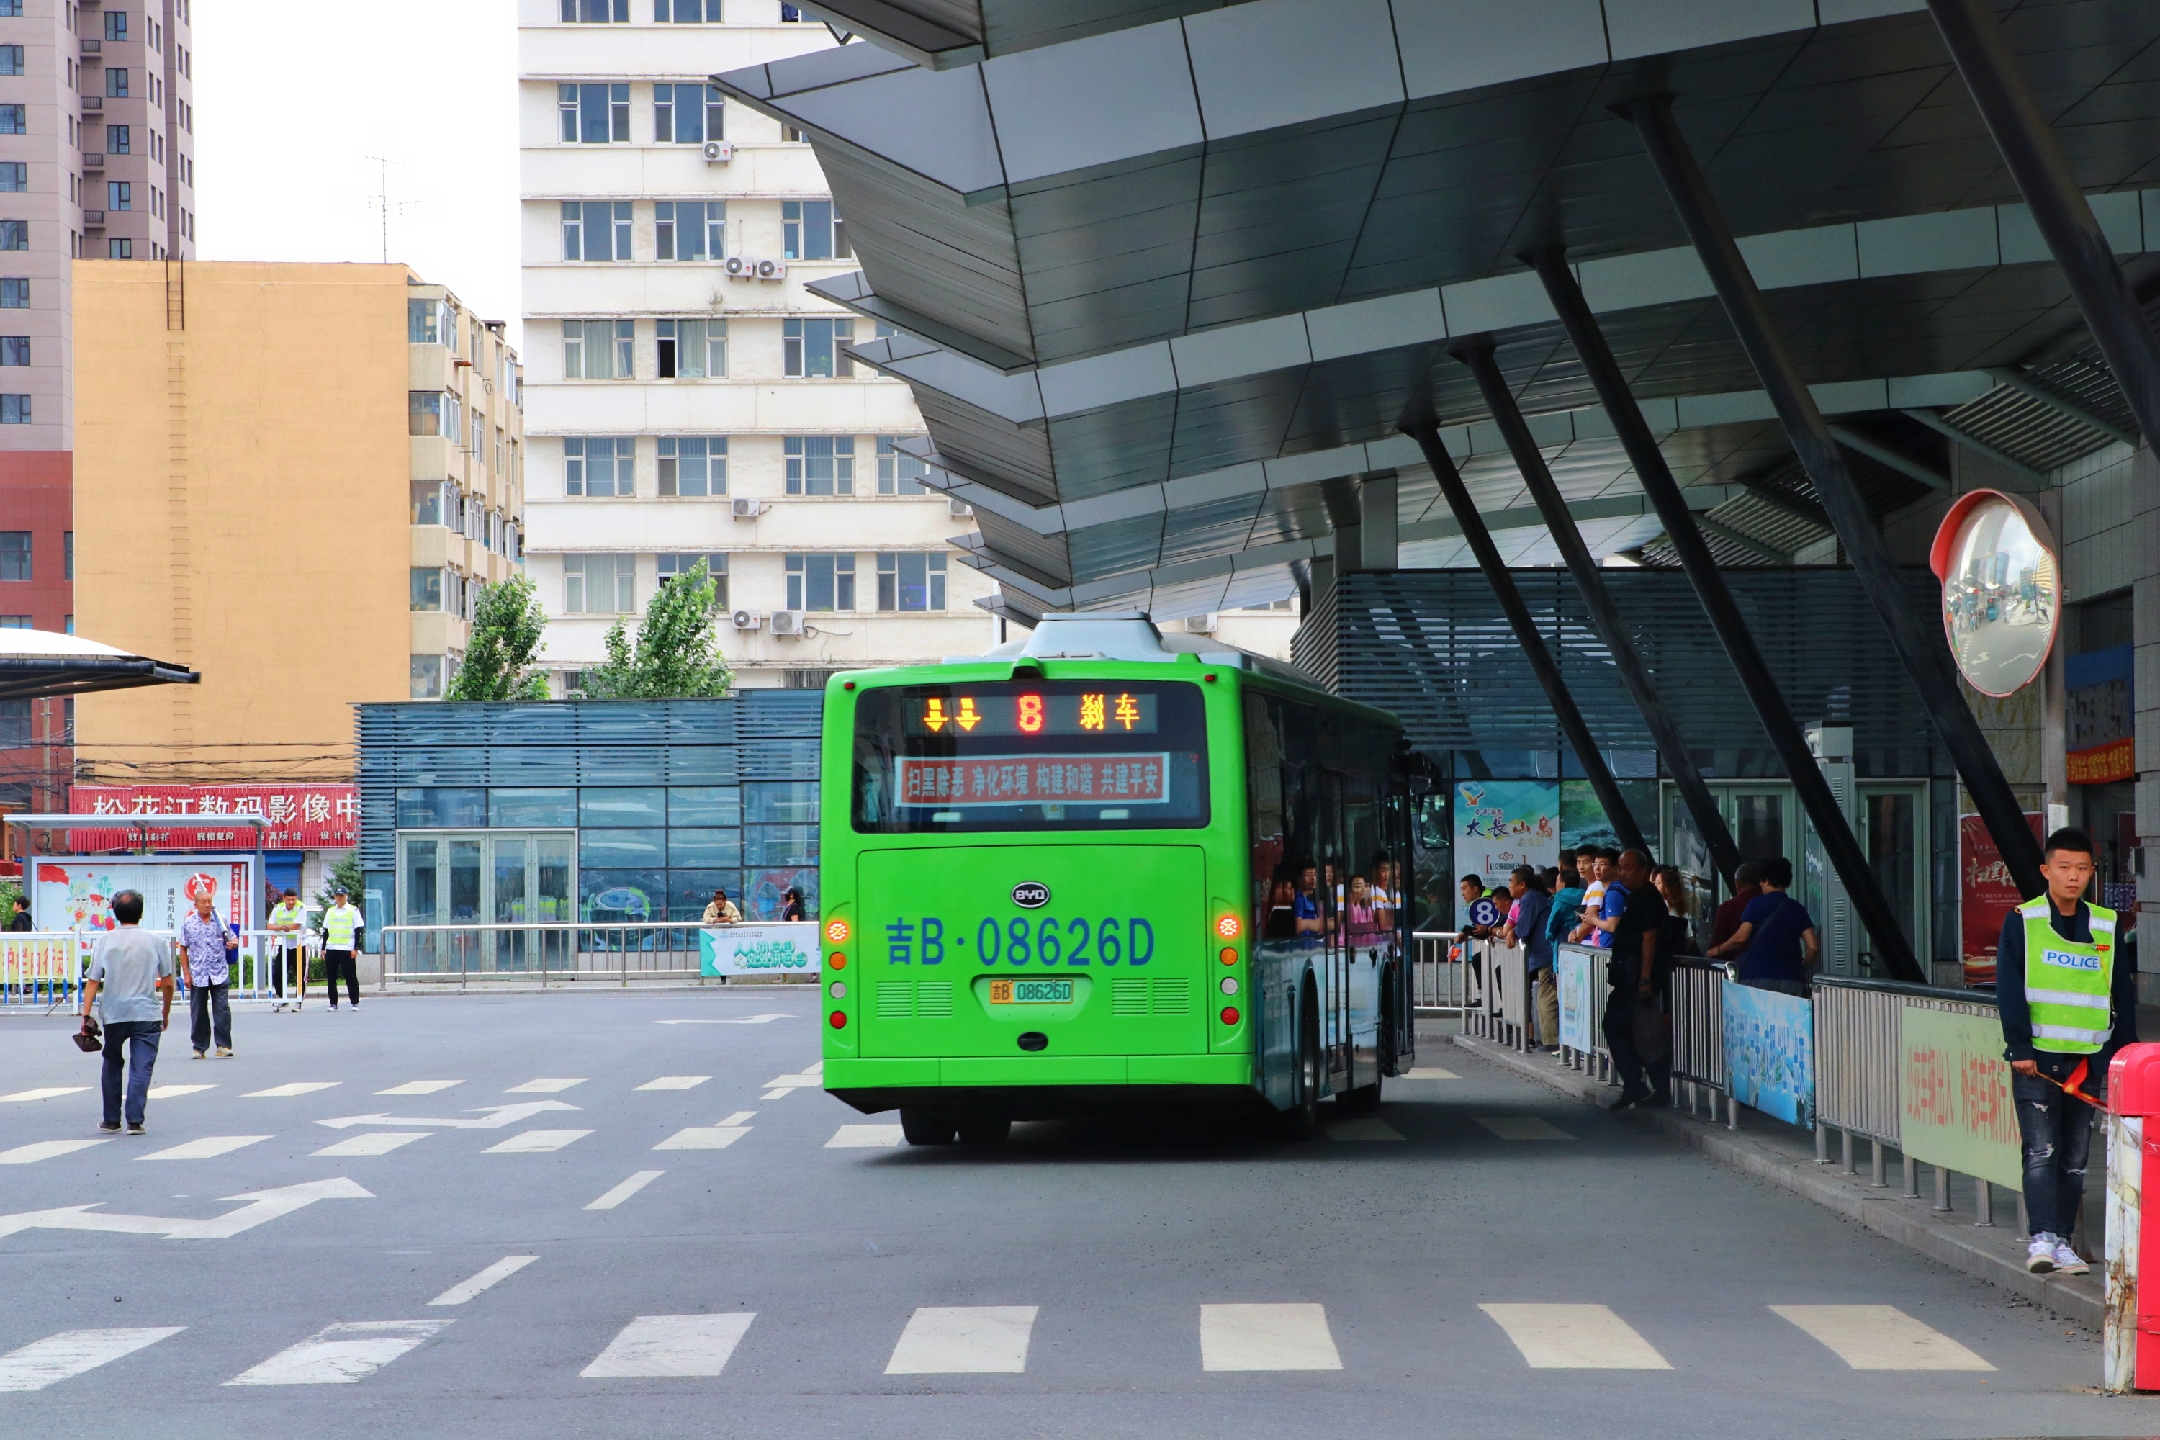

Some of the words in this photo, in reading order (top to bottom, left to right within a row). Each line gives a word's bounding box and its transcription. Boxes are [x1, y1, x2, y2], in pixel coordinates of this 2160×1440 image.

[1019, 695, 1042, 732] 8
[1080, 693, 1140, 730] 刹车
[907, 765, 965, 798] 扫黑除恶
[971, 763, 1029, 797] 净化环境
[1035, 763, 1094, 796] 构建和谐
[1100, 761, 1159, 795] 共建平安
[1015, 889, 1046, 900] BYD
[1476, 901, 1494, 924] 8
[886, 916, 1154, 966] 吉B·08626D
[2047, 951, 2098, 968] POLICE
[1906, 1043, 1954, 1129] 公交车辆出入
[1960, 1049, 2022, 1147] 外部车辆行人
